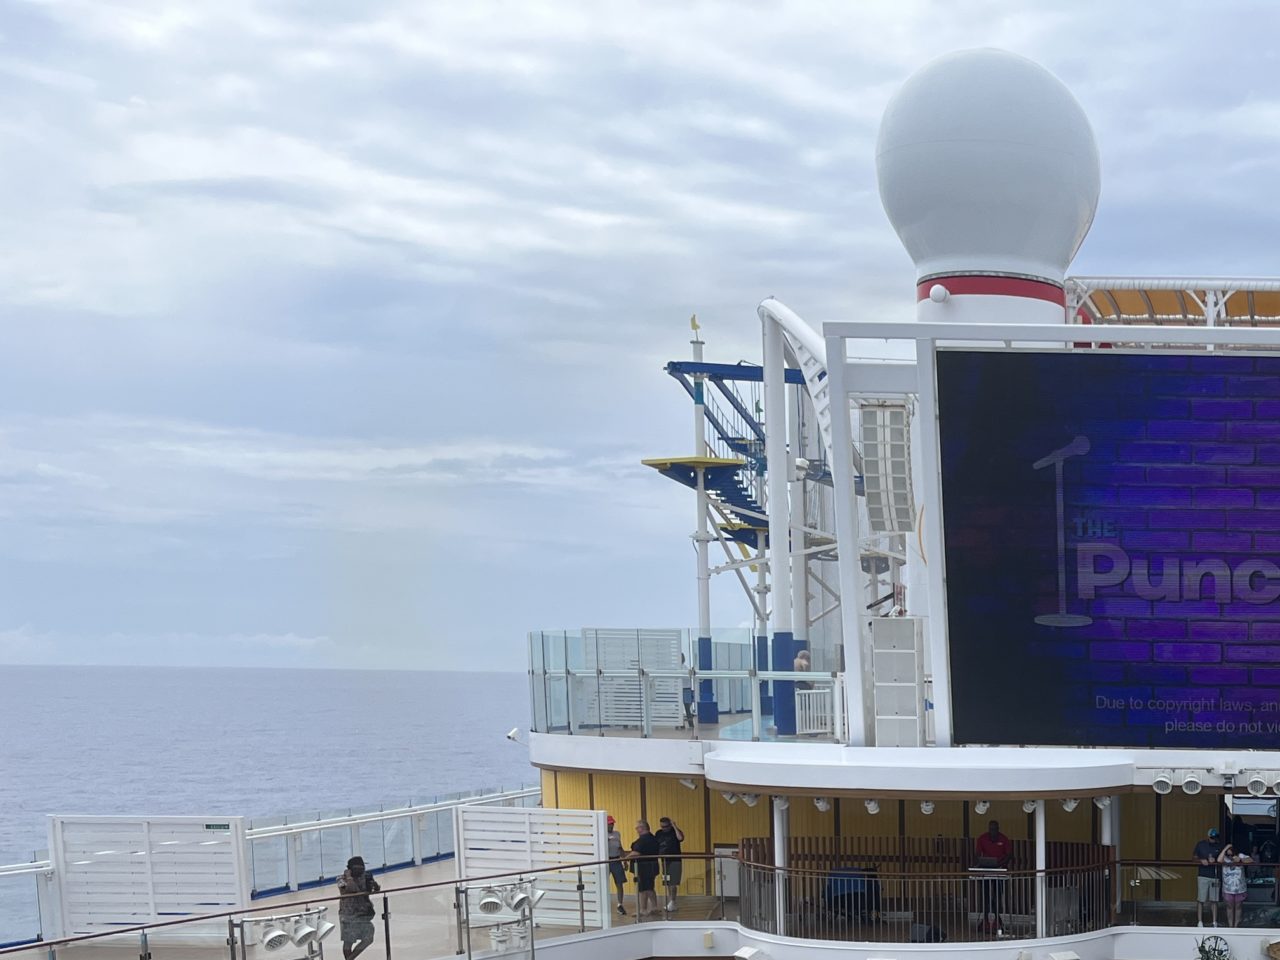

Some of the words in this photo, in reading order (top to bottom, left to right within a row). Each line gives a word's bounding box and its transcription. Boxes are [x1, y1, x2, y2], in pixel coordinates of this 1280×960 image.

[1072, 517, 1119, 538] THE
[1095, 695, 1125, 709] Due
[1129, 697, 1143, 710] to
[1147, 697, 1215, 713] copyright
[1219, 697, 1255, 713] laws,
[1165, 718, 1212, 734] please
[1216, 719, 1235, 733] do
[1239, 721, 1263, 733] not
